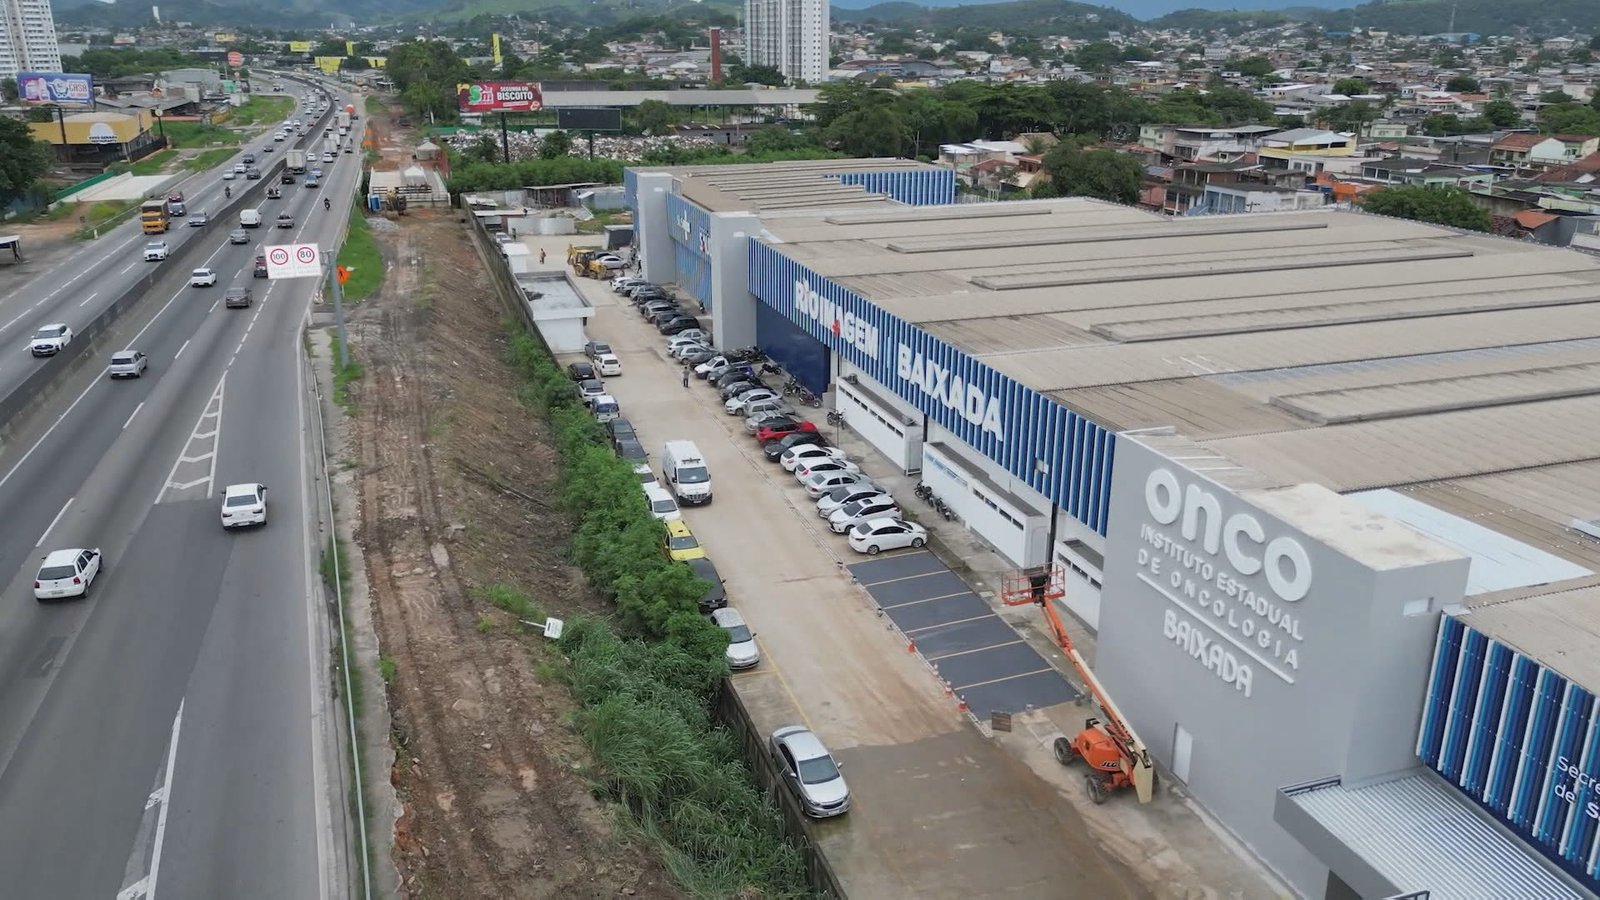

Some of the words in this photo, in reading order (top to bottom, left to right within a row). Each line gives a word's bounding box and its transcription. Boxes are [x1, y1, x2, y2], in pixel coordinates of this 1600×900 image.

[497, 92, 533, 101] BISCOITO
[300, 250, 312, 258] 80
[897, 342, 1004, 442] BAIXADA
[1145, 468, 1313, 602] onco
[1136, 548, 1162, 575] DE
[1170, 567, 1300, 670] ONCOLOGIA
[1140, 523, 1214, 582] INSTITUTO
[1216, 572, 1304, 641] ESTADUAL
[1163, 608, 1254, 698] BAIXADA
[1101, 760, 1117, 768] JLG
[1554, 785, 1577, 805] de
[1585, 802, 1600, 821] S
